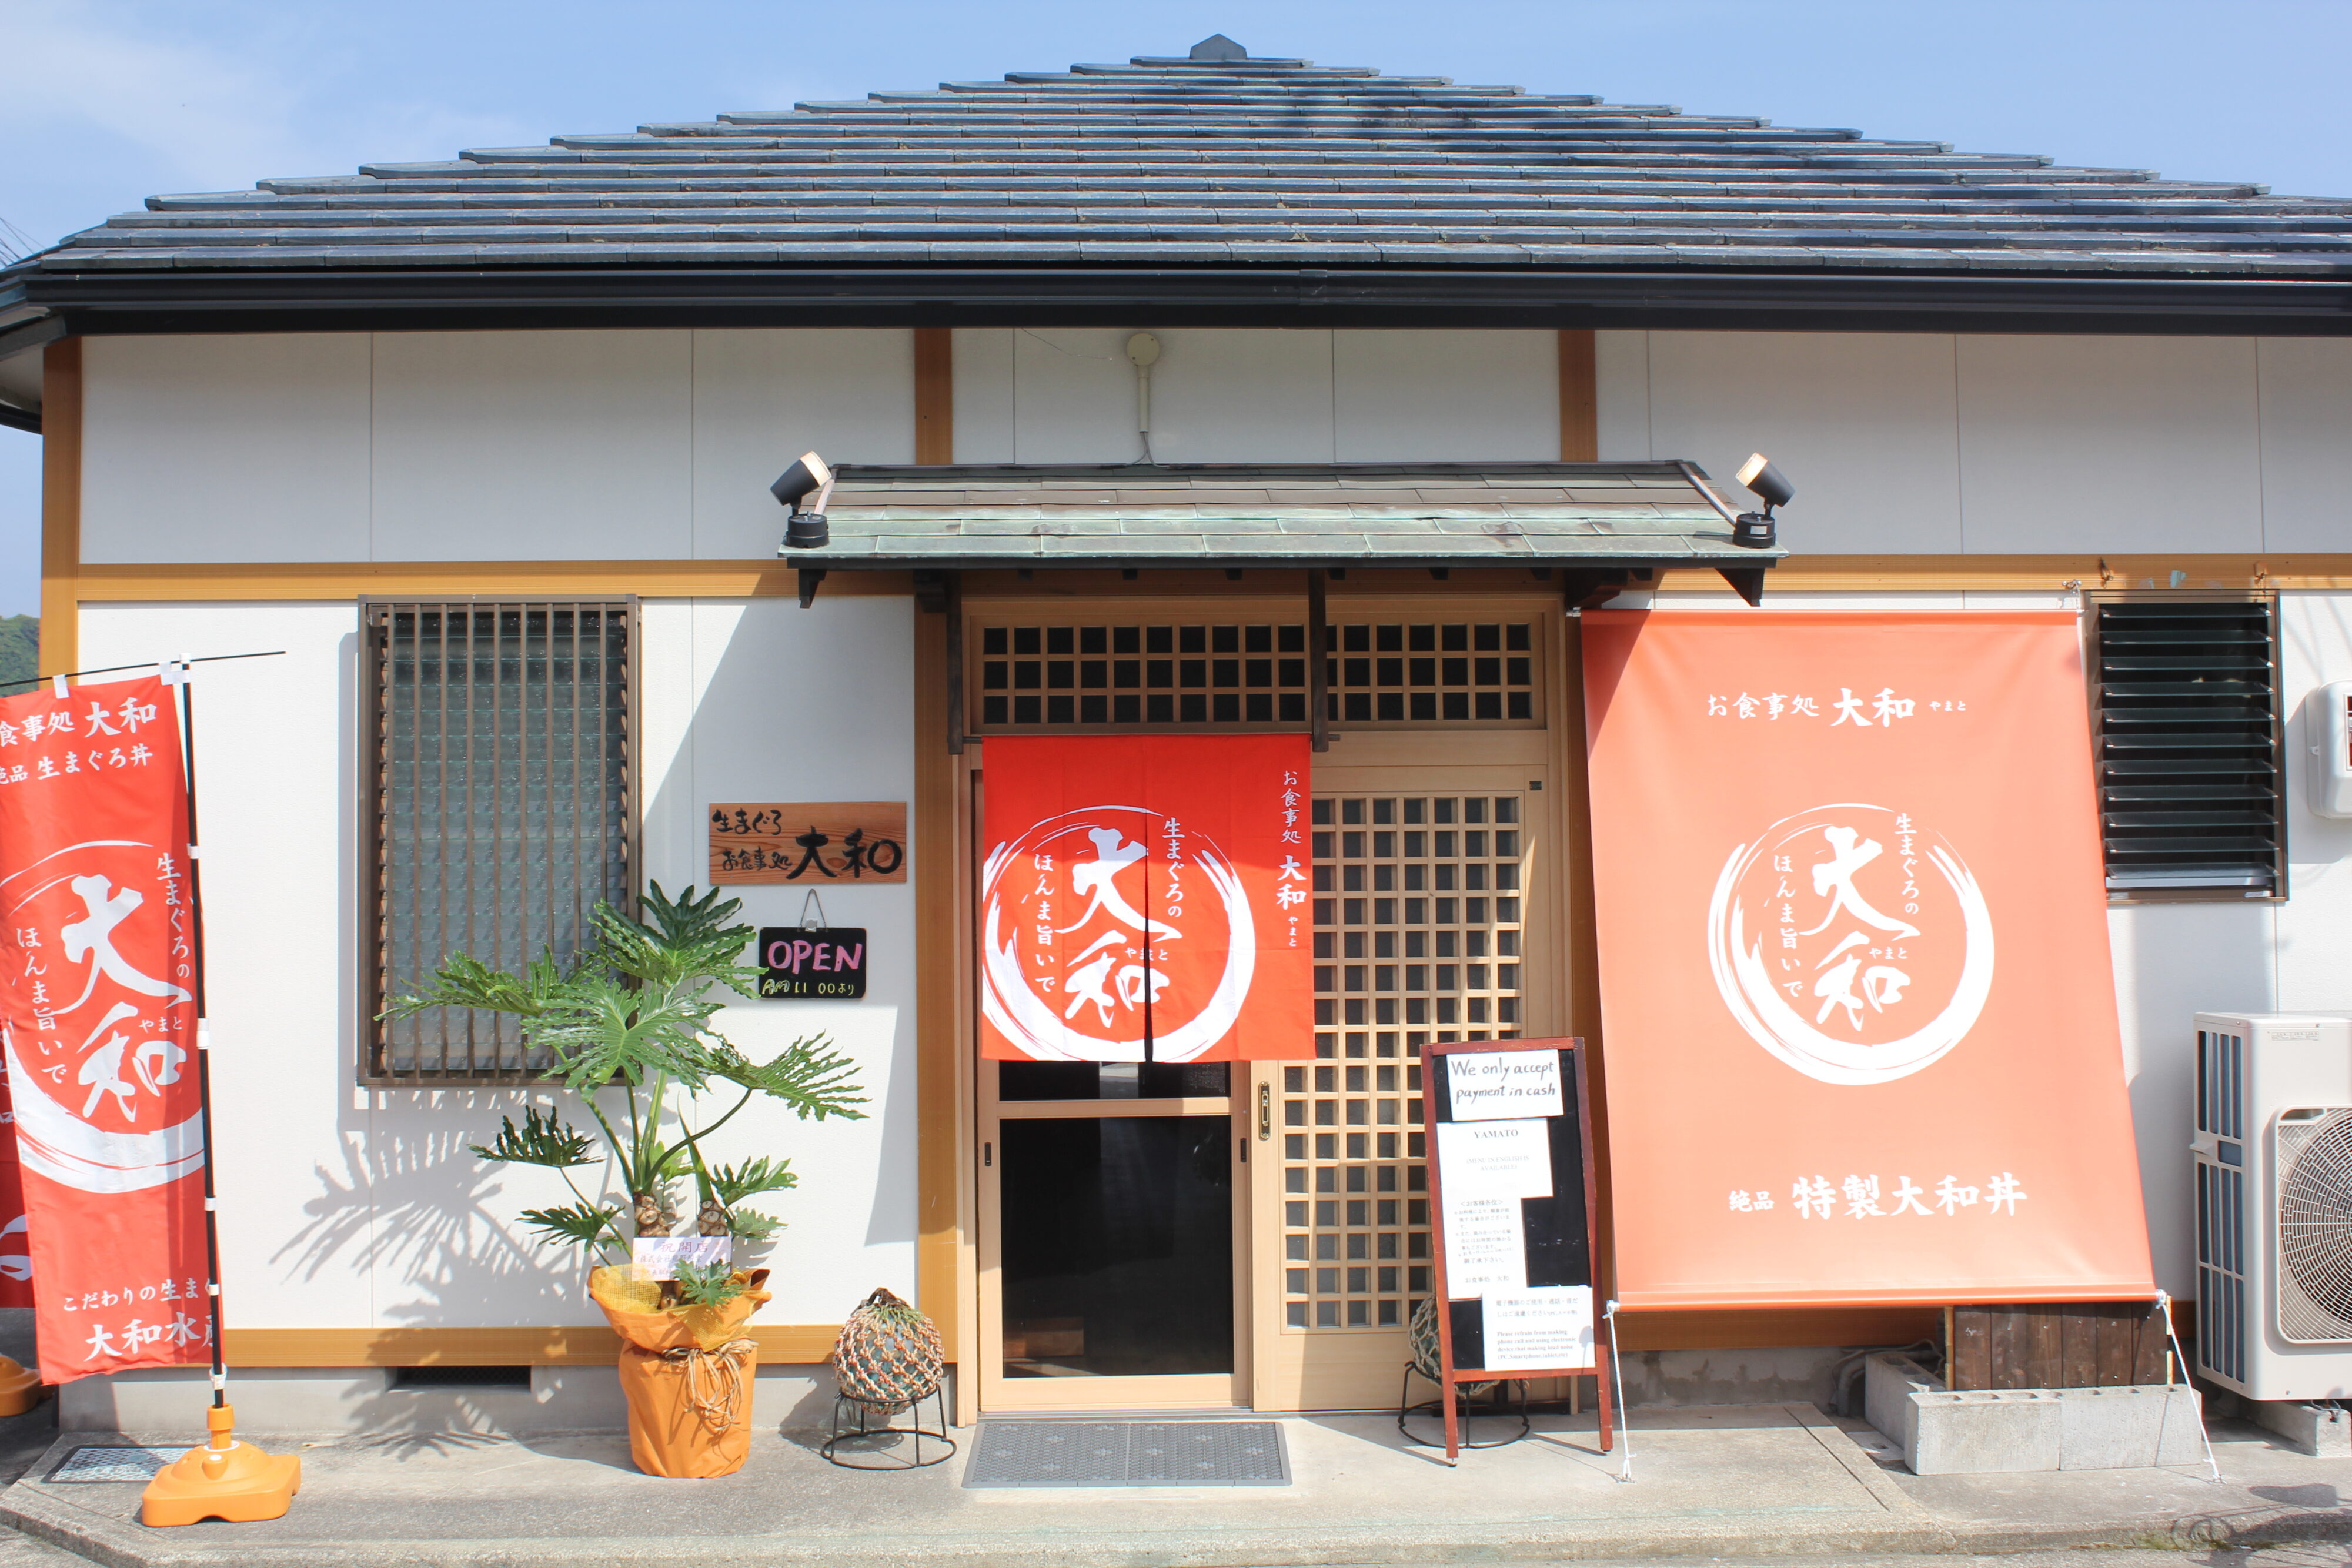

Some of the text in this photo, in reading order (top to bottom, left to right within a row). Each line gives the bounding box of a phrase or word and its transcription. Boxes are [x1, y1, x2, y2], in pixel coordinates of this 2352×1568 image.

[84, 697, 157, 737] 大和
[1707, 687, 1966, 727] お食事処 大和 やまと
[37, 743, 153, 780] 生まぐろ丼
[712, 808, 781, 835] 生まぐろ
[722, 825, 903, 880] お食事処 大和
[1162, 817, 1185, 918] 生まぐろの
[1276, 770, 1307, 947] お食事処 大和 やまと
[1895, 813, 1919, 915] 生まぐろの
[156, 852, 190, 978] 生まぐろの
[1034, 854, 1056, 993] ほんま旨いで
[1054, 827, 1182, 1028] 大和
[1774, 855, 1803, 997] ほんま旨いで
[1799, 825, 1920, 1032] 大和
[767, 940, 863, 974] OPEN
[1125, 947, 1168, 961] やまと
[1869, 947, 1908, 959] やまと
[16, 927, 67, 1084] ほんま旨いで
[55, 874, 192, 1122] 大和
[139, 1015, 182, 1033] やまと
[1451, 1057, 1553, 1082] We only accept
[1456, 1082, 1555, 1105] payment in cash
[1474, 1129, 1518, 1139] YAMATO
[1728, 1172, 2027, 1220] 絶品 特製大和丼
[661, 1241, 708, 1253] 祝開店
